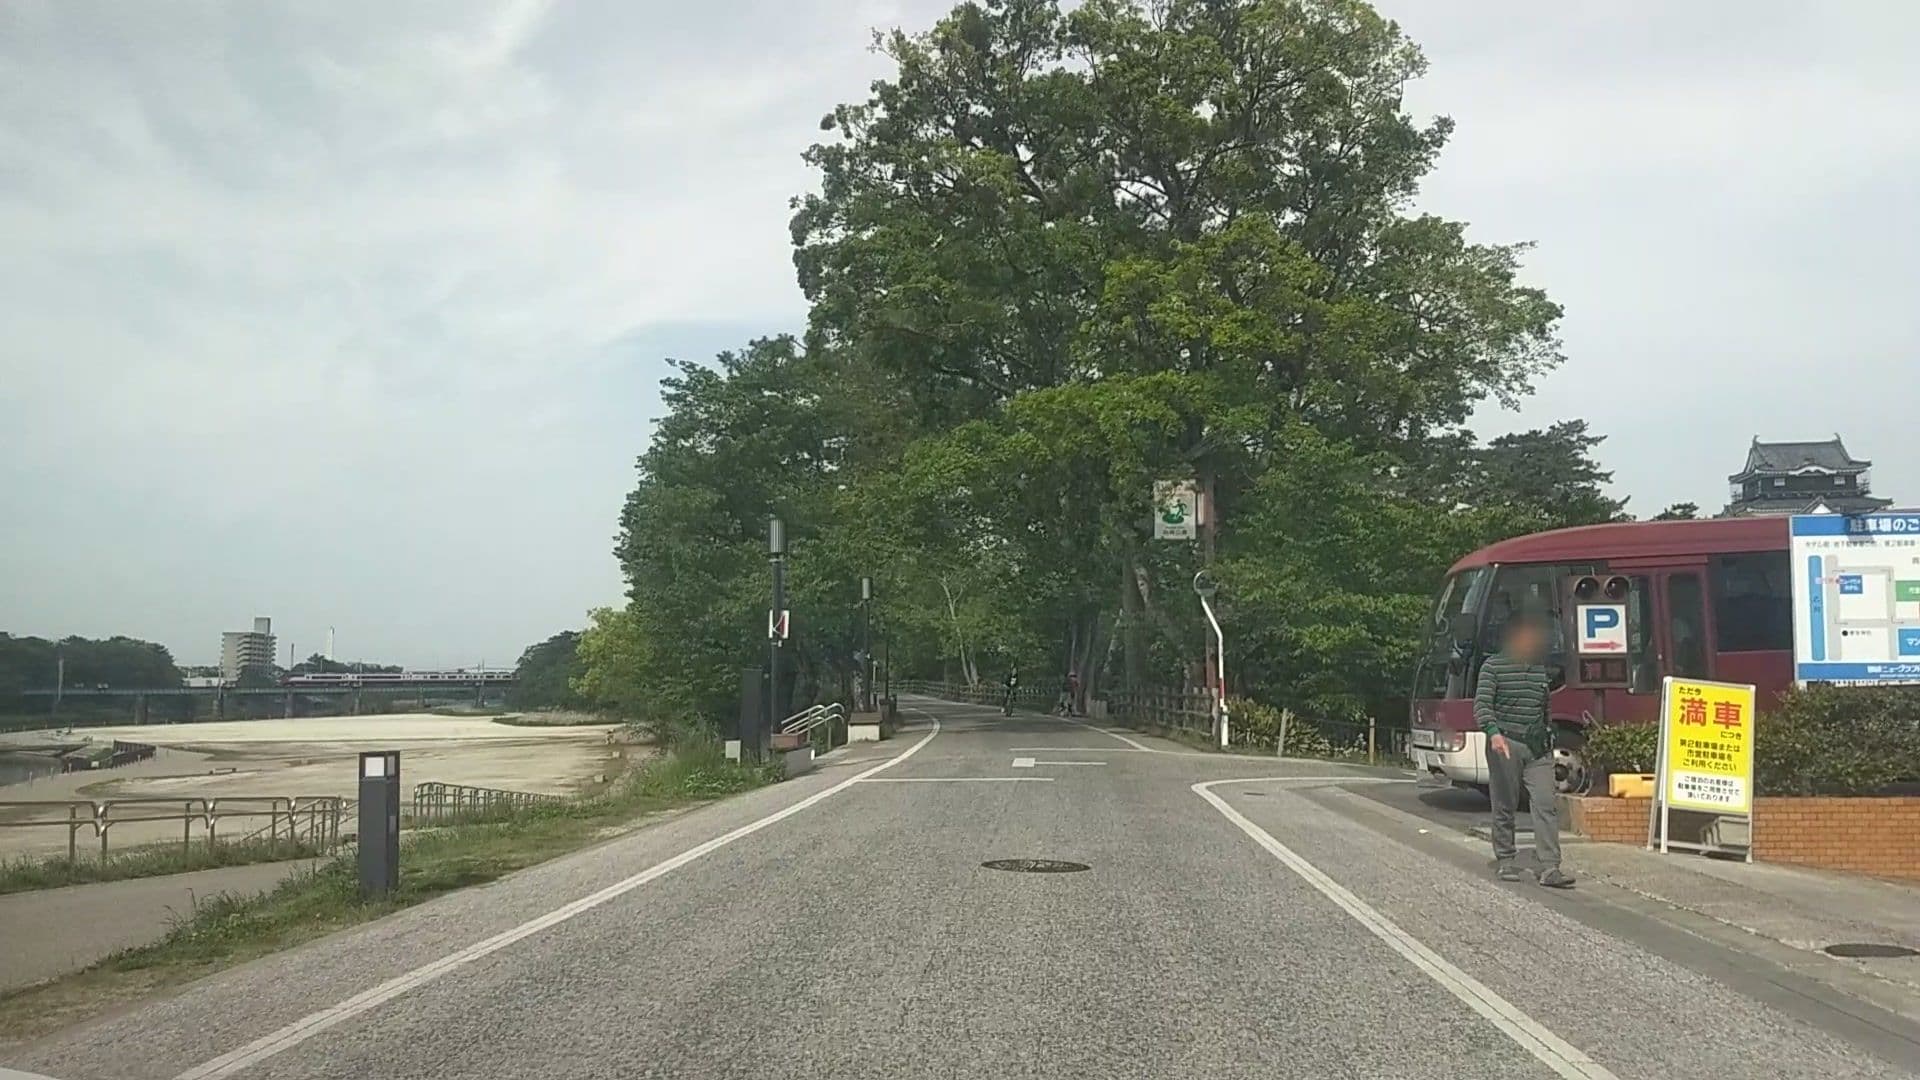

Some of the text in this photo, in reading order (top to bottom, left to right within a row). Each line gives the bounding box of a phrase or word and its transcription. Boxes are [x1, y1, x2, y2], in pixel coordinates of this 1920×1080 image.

[1586, 608, 1619, 638] P
[1679, 687, 1701, 696] ただ今
[1679, 697, 1742, 729] 満車
[1720, 731, 1742, 740] につき
[1683, 759, 1737, 771] ご利用ください
